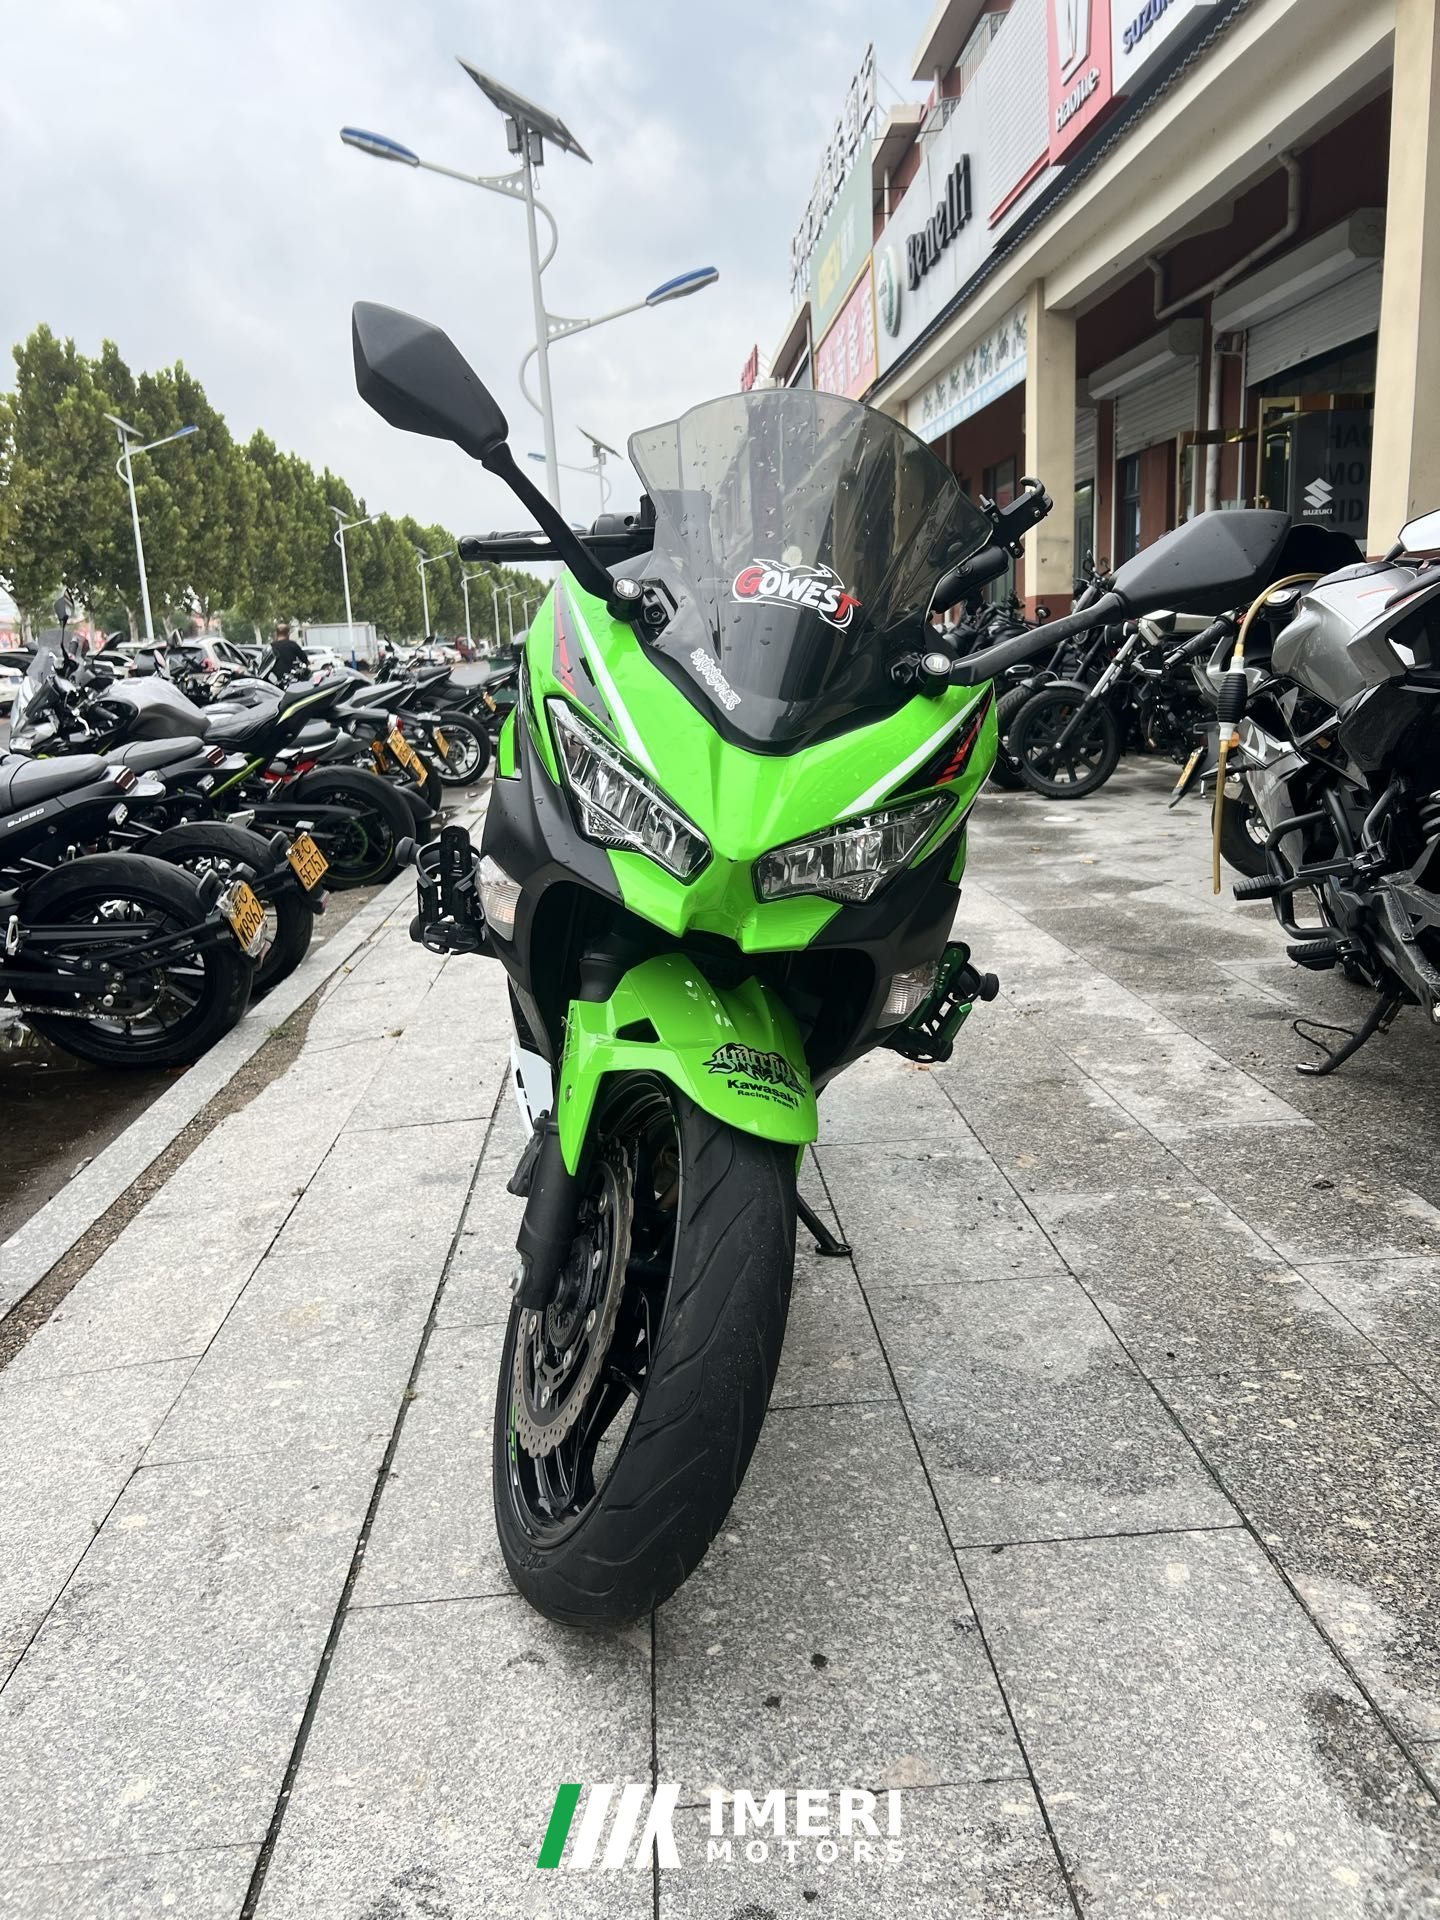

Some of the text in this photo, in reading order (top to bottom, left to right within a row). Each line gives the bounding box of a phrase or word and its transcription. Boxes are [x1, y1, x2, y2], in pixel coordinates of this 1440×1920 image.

[1123, 0, 1175, 55] SUZU
[906, 153, 973, 291] Benelli
[1302, 508, 1333, 517] SUZUKI
[734, 566, 863, 620] GOWEST
[690, 647, 742, 711] MONSTER
[299, 850, 326, 886] 5E757
[727, 1079, 800, 1108] Kawasaki
[737, 1089, 795, 1110] Racing Team
